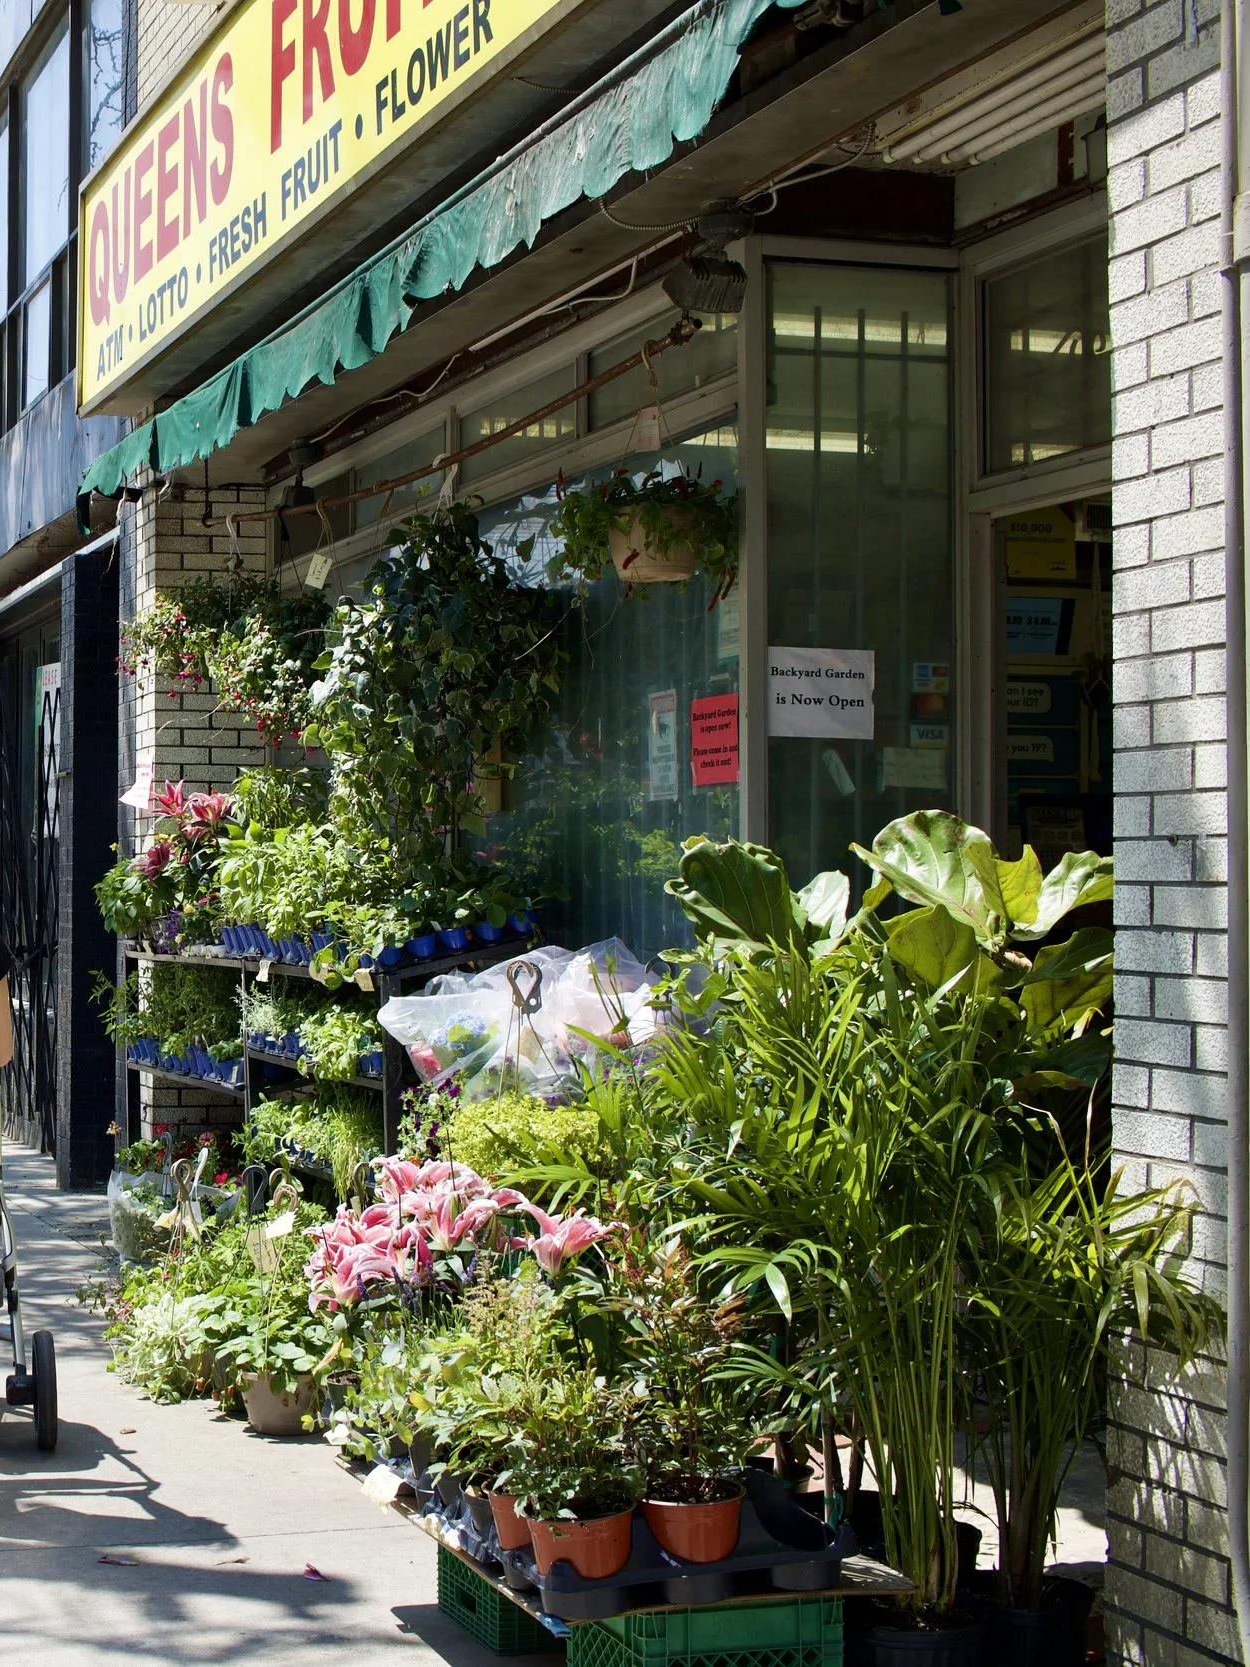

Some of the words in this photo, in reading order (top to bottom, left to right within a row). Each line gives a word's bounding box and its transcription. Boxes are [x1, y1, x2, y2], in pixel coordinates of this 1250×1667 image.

[89, 52, 234, 327] QUEENS
[96, 324, 124, 382] ATM
[138, 266, 189, 343] LOTTO
[208, 191, 268, 285] FRESH
[280, 120, 343, 221] FRUIT
[375, 0, 494, 136] FLOWER
[770, 666, 822, 681] Backyard
[825, 667, 866, 680] Garden
[775, 693, 787, 706] is
[790, 693, 824, 707] Now
[828, 694, 866, 710] Open
[693, 710, 717, 722] Backyard
[717, 708, 737, 718] Garden
[705, 724, 718, 734] open
[917, 728, 945, 741] VISA
[693, 747, 708, 757] Please
